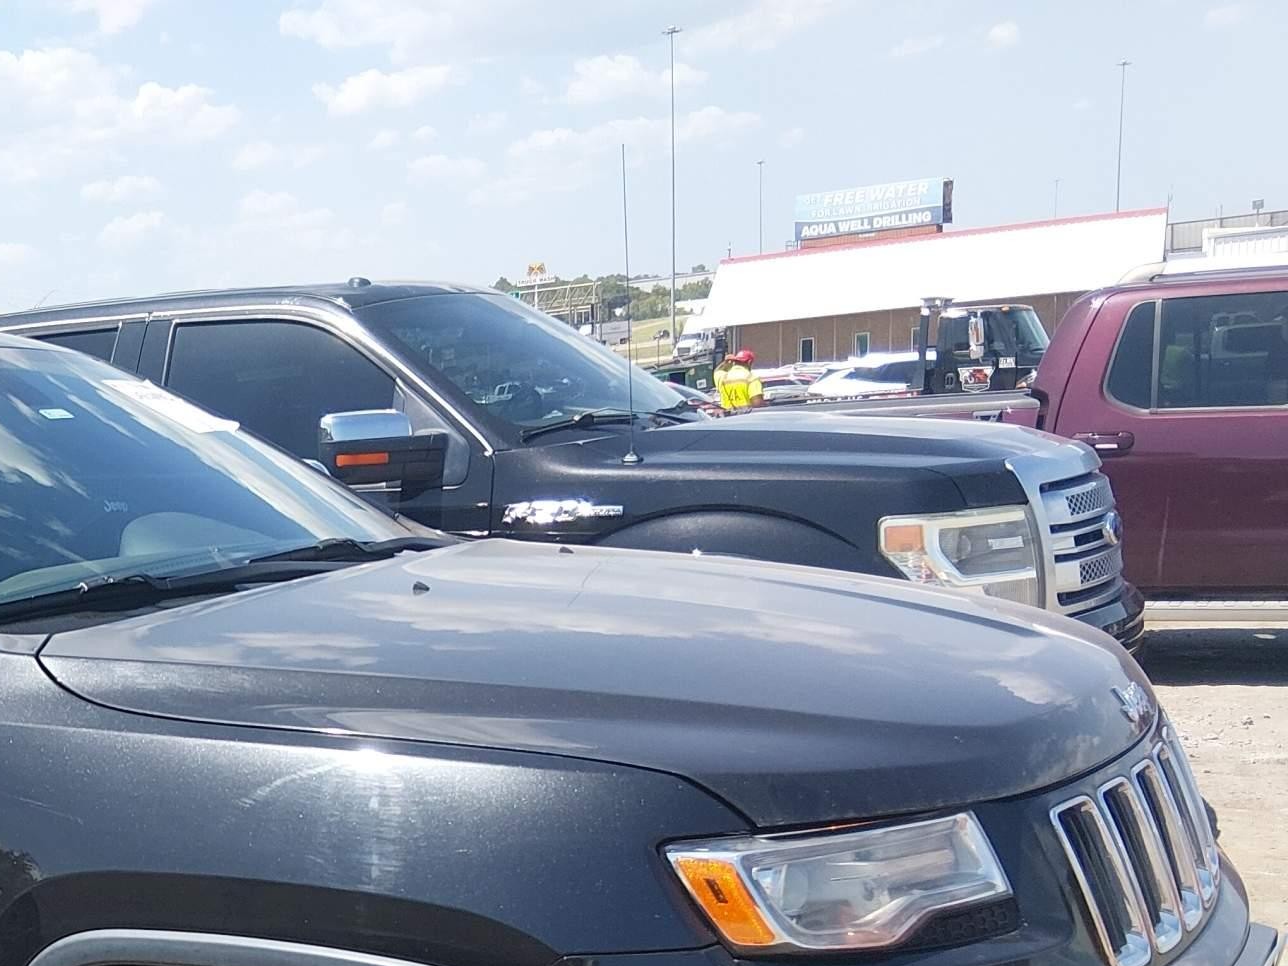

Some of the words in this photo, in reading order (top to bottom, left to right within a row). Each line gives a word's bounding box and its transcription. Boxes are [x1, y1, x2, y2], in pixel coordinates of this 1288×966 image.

[823, 190, 865, 207] FREE
[867, 181, 929, 201] WATER
[800, 222, 837, 238] AQUA
[838, 217, 872, 233] WELL
[873, 210, 932, 227] DRILLING
[811, 208, 834, 219] FOR
[834, 205, 859, 217] LAWN
